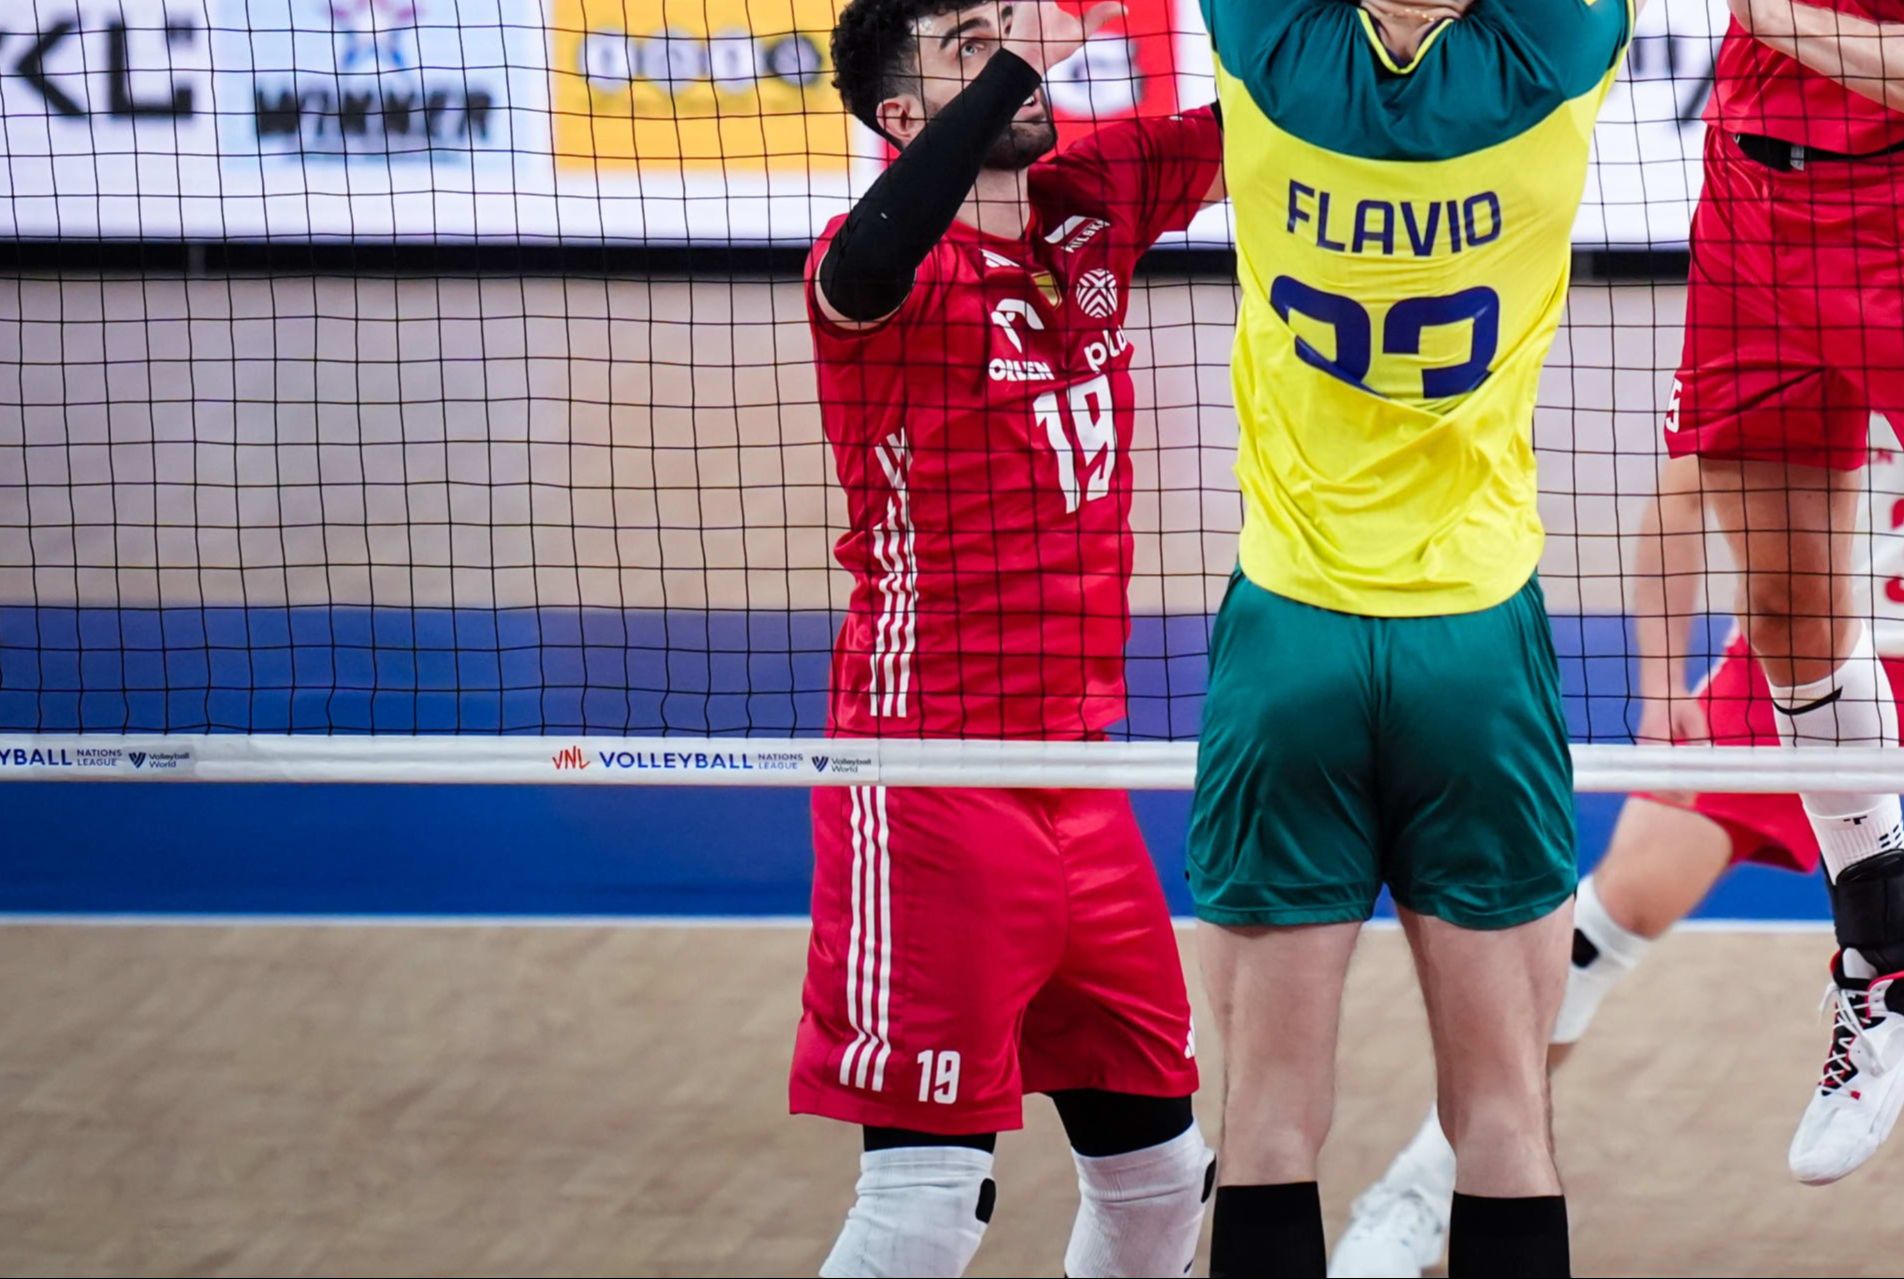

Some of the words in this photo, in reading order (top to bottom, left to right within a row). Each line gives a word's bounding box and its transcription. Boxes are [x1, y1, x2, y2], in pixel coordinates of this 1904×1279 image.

[1286, 179, 1502, 257] FLAVIO
[1032, 374, 1116, 515] 19
[76, 749, 122, 757] NATIONS
[76, 758, 118, 766] LEAGUE
[598, 751, 754, 769] VOLLEYBALL
[757, 753, 804, 761] NATIONS
[916, 1049, 961, 1106] 19
